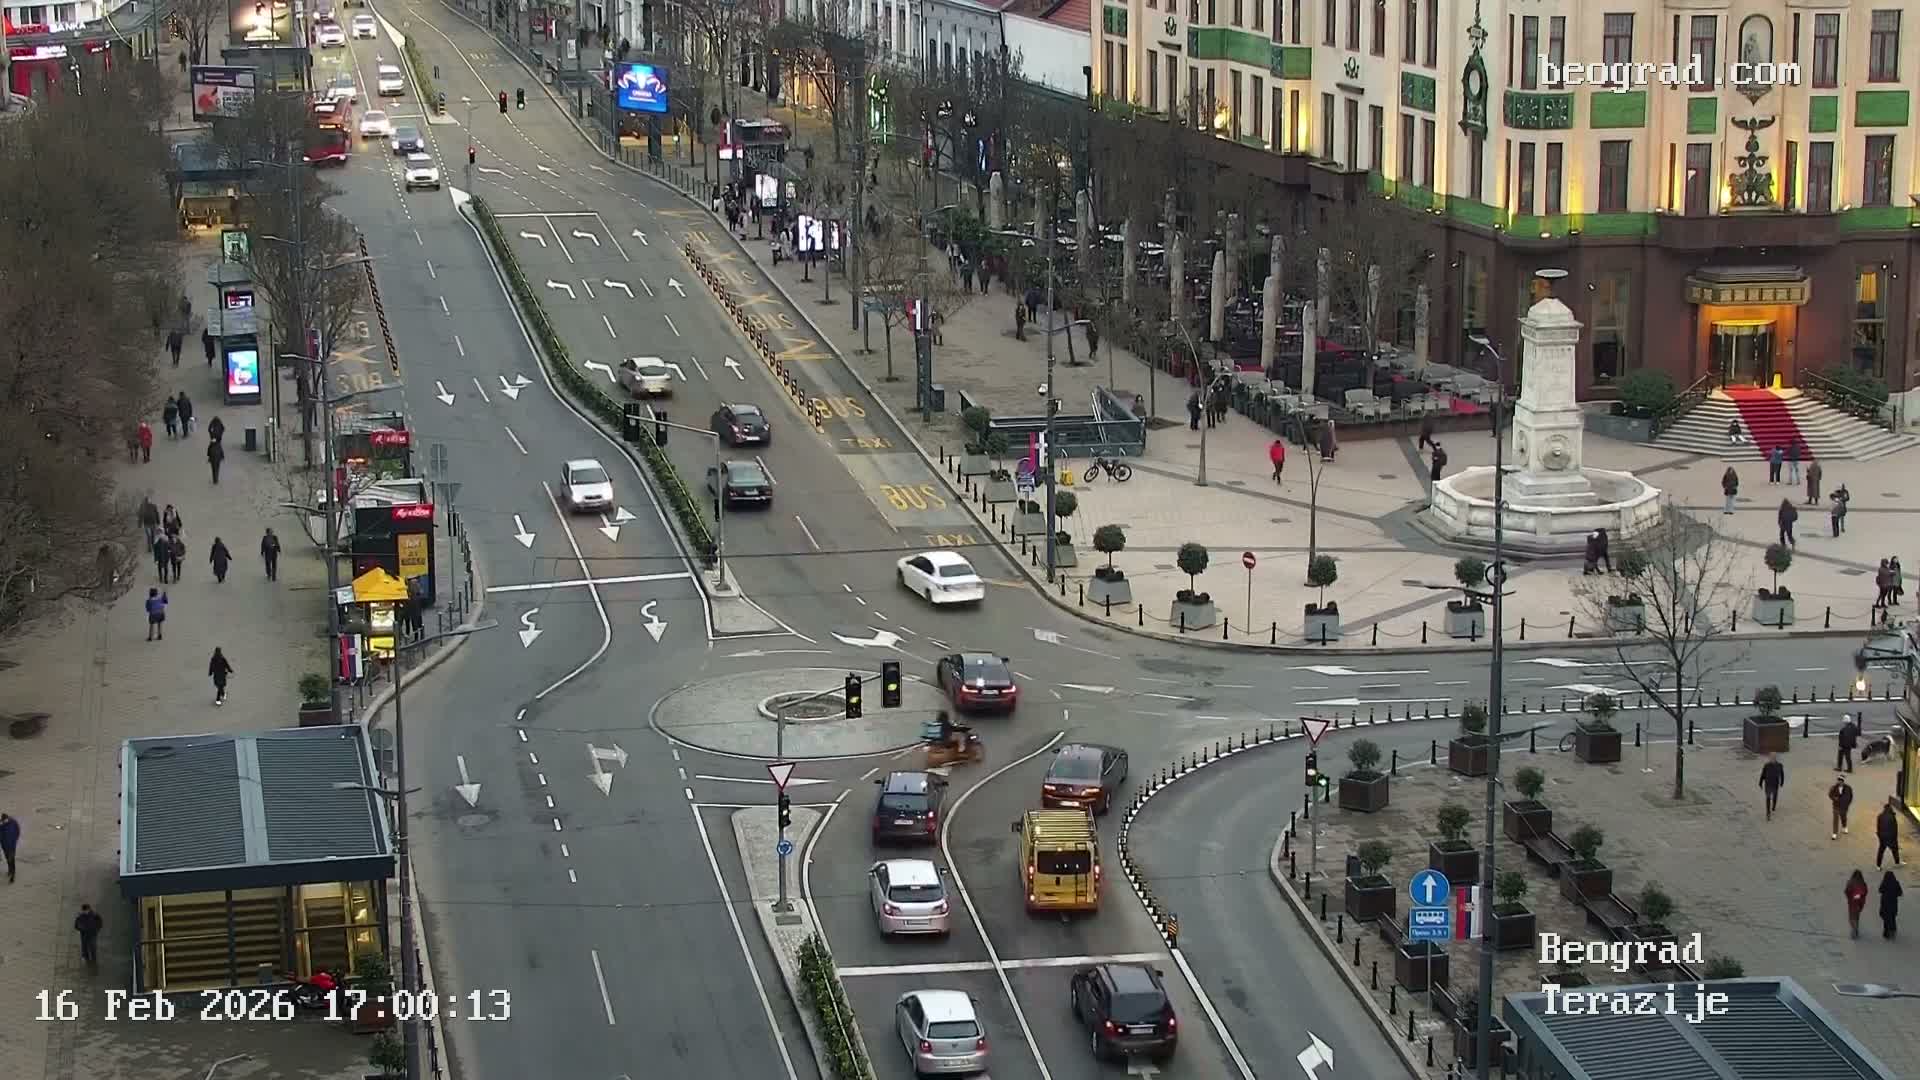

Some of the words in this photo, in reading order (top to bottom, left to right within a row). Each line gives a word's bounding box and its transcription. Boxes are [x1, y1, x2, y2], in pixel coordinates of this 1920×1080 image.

[747, 311, 796, 331] BUS
[812, 397, 866, 419] BUS
[879, 484, 947, 511] BUS
[921, 534, 977, 546] TAXI
